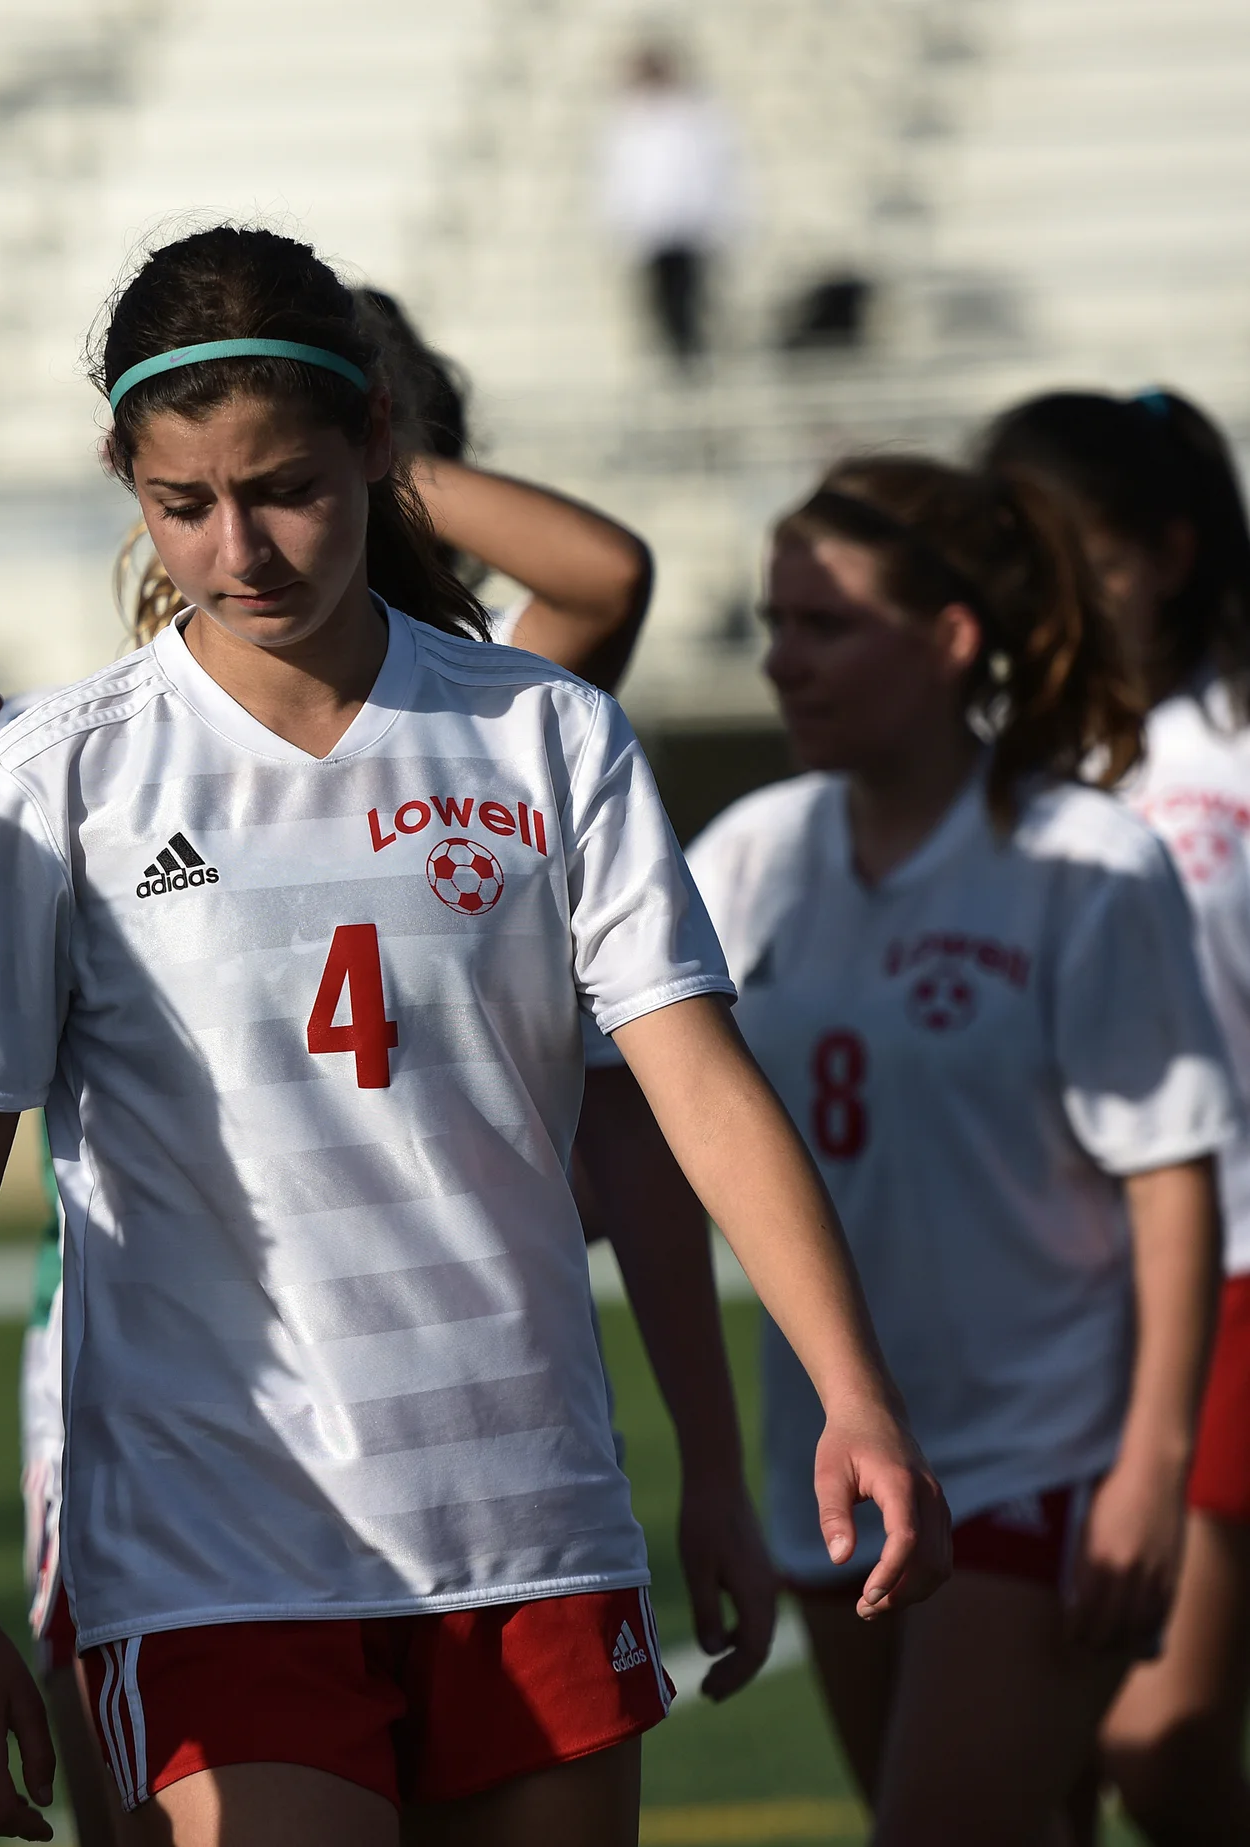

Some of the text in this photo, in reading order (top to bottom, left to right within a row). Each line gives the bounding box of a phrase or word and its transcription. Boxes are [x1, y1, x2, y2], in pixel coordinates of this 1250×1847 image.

[367, 796, 547, 857] Lowell
[136, 867, 219, 899] adidas
[307, 923, 399, 1089] 4
[812, 1027, 869, 1165] 8
[612, 1648, 647, 1673] adidas
